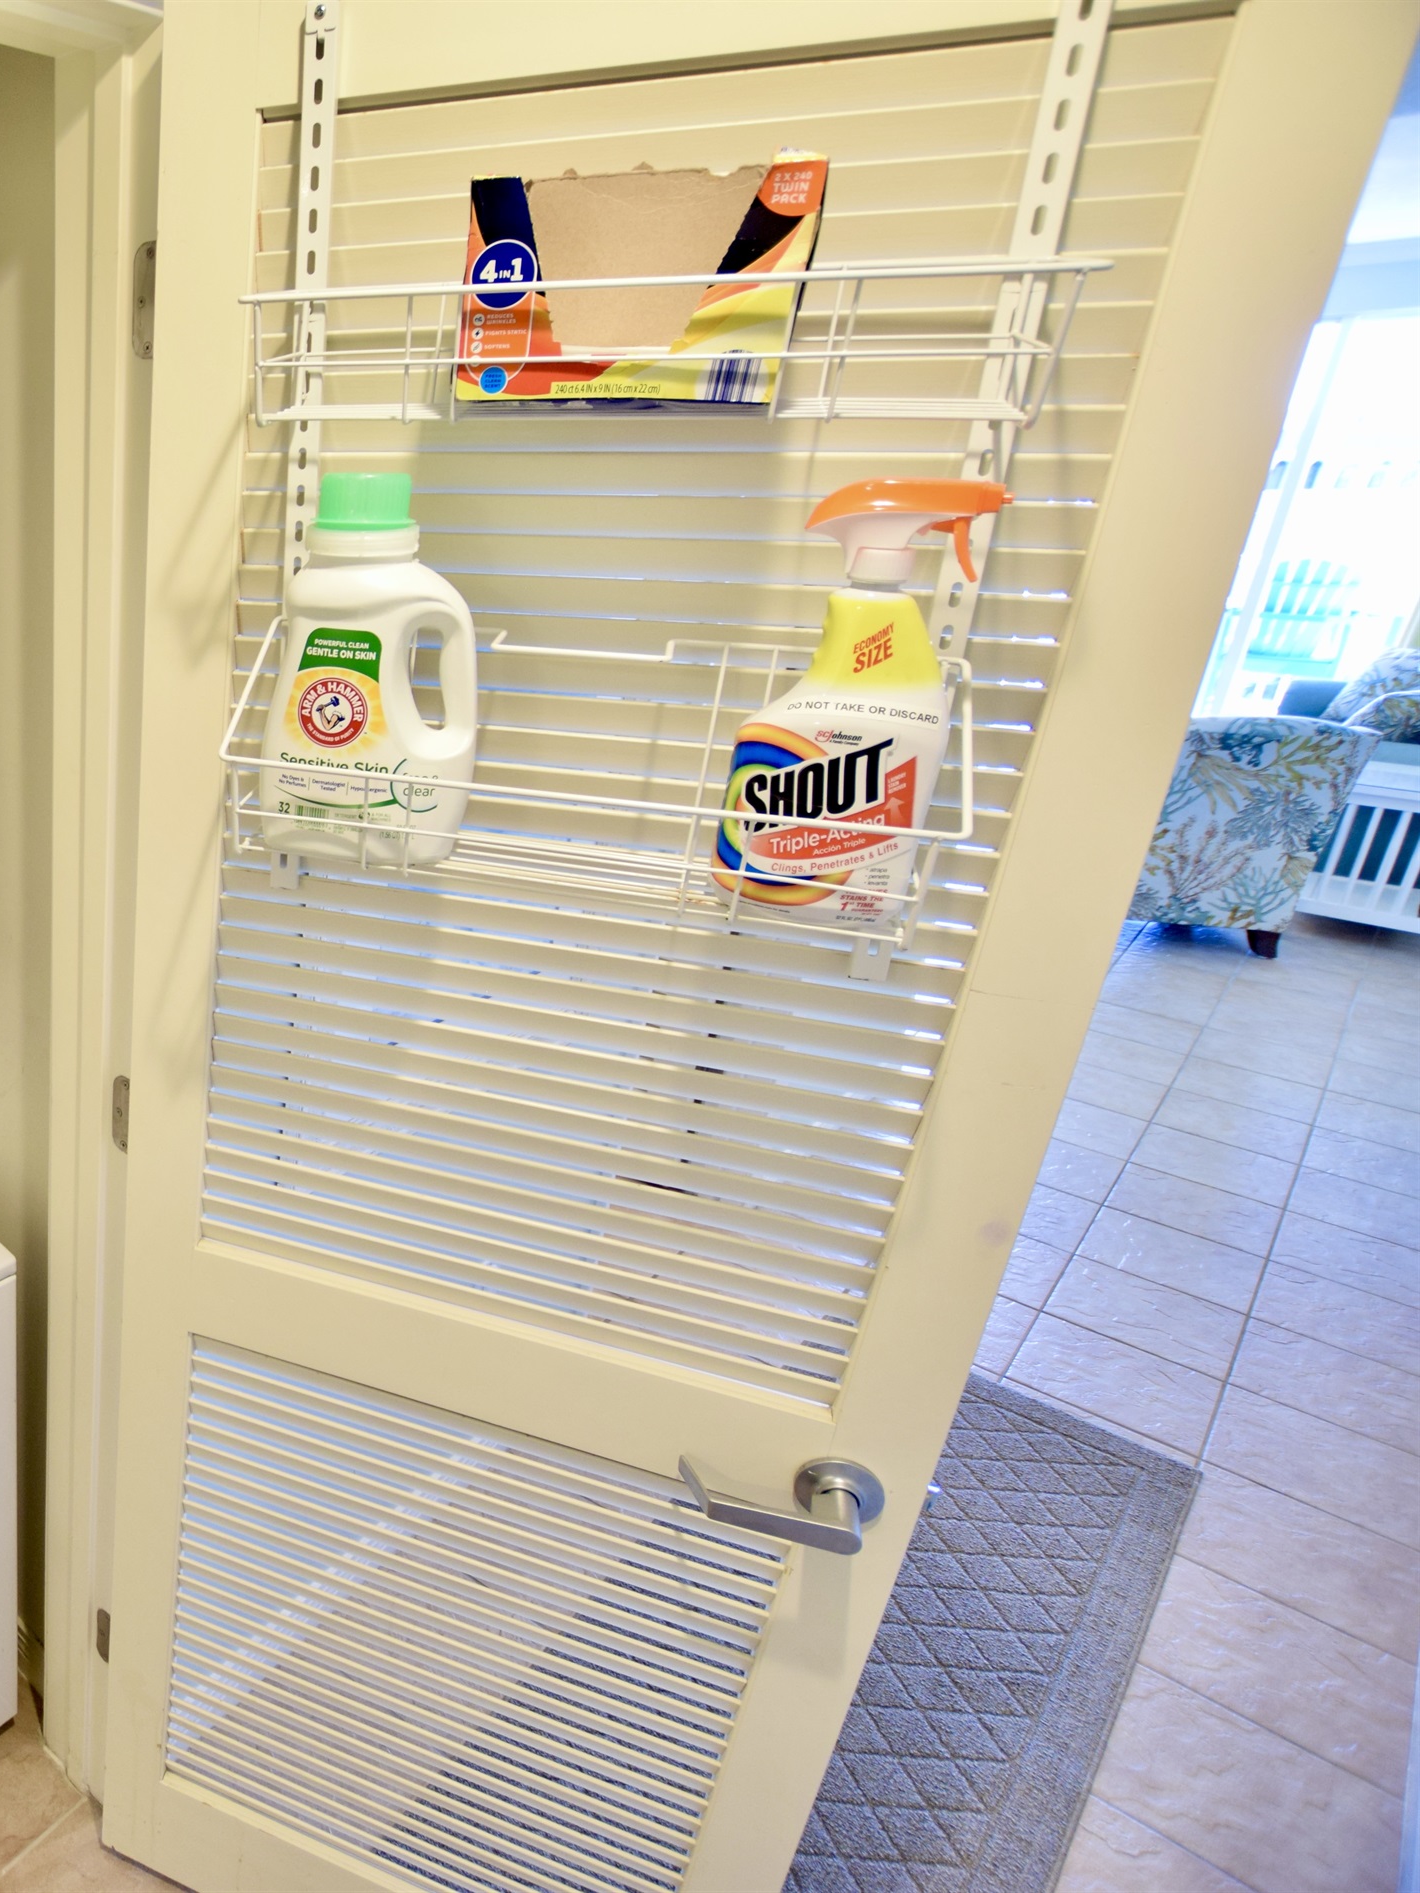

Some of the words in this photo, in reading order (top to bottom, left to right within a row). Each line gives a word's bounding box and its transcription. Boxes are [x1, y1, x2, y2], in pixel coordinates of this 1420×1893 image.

[775, 173, 781, 181] 2
[793, 170, 813, 180] 240
[773, 181, 810, 193] TWIN
[770, 193, 807, 204] PACK
[479, 259, 499, 283] 4
[499, 269, 511, 279] IN
[510, 257, 524, 282] 1
[555, 384, 567, 394] 240
[574, 383, 585, 393] 6.4
[585, 383, 593, 393] IN
[599, 384, 604, 392] 9
[604, 383, 611, 393] IN
[611, 383, 622, 395] (16
[623, 385, 633, 393] cm
[638, 384, 647, 393] 22
[647, 384, 661, 395] cm)
[314, 639, 348, 648] POWERFUL
[348, 641, 370, 649] CLEAN
[853, 621, 895, 654] ECONOMY
[306, 646, 339, 658] GENTLE
[339, 650, 354, 659] ON
[354, 651, 377, 661] SKIN
[853, 637, 893, 673] SIZE
[301, 689, 319, 717] ARM
[316, 684, 327, 695] &
[327, 681, 364, 722] HAMMER
[787, 702, 802, 711] DO
[805, 701, 830, 710] NOT
[834, 702, 865, 713] TAKE
[868, 705, 886, 715] OR
[889, 708, 939, 725] DISCARD
[306, 722, 315, 733] THE
[312, 729, 334, 742] STANDARD
[280, 752, 349, 771] Sensitive
[354, 761, 389, 775] Skin
[286, 780, 307, 788] Perfumes
[312, 778, 346, 788] Dermatologist
[744, 737, 894, 833] SHOUT
[278, 801, 291, 814] 32
[812, 844, 842, 857] Acción
[842, 838, 866, 849] Triple
[771, 862, 807, 875] Clings,
[810, 854, 866, 872] Penetrates
[868, 850, 874, 859] &
[877, 842, 899, 856] Lifts
